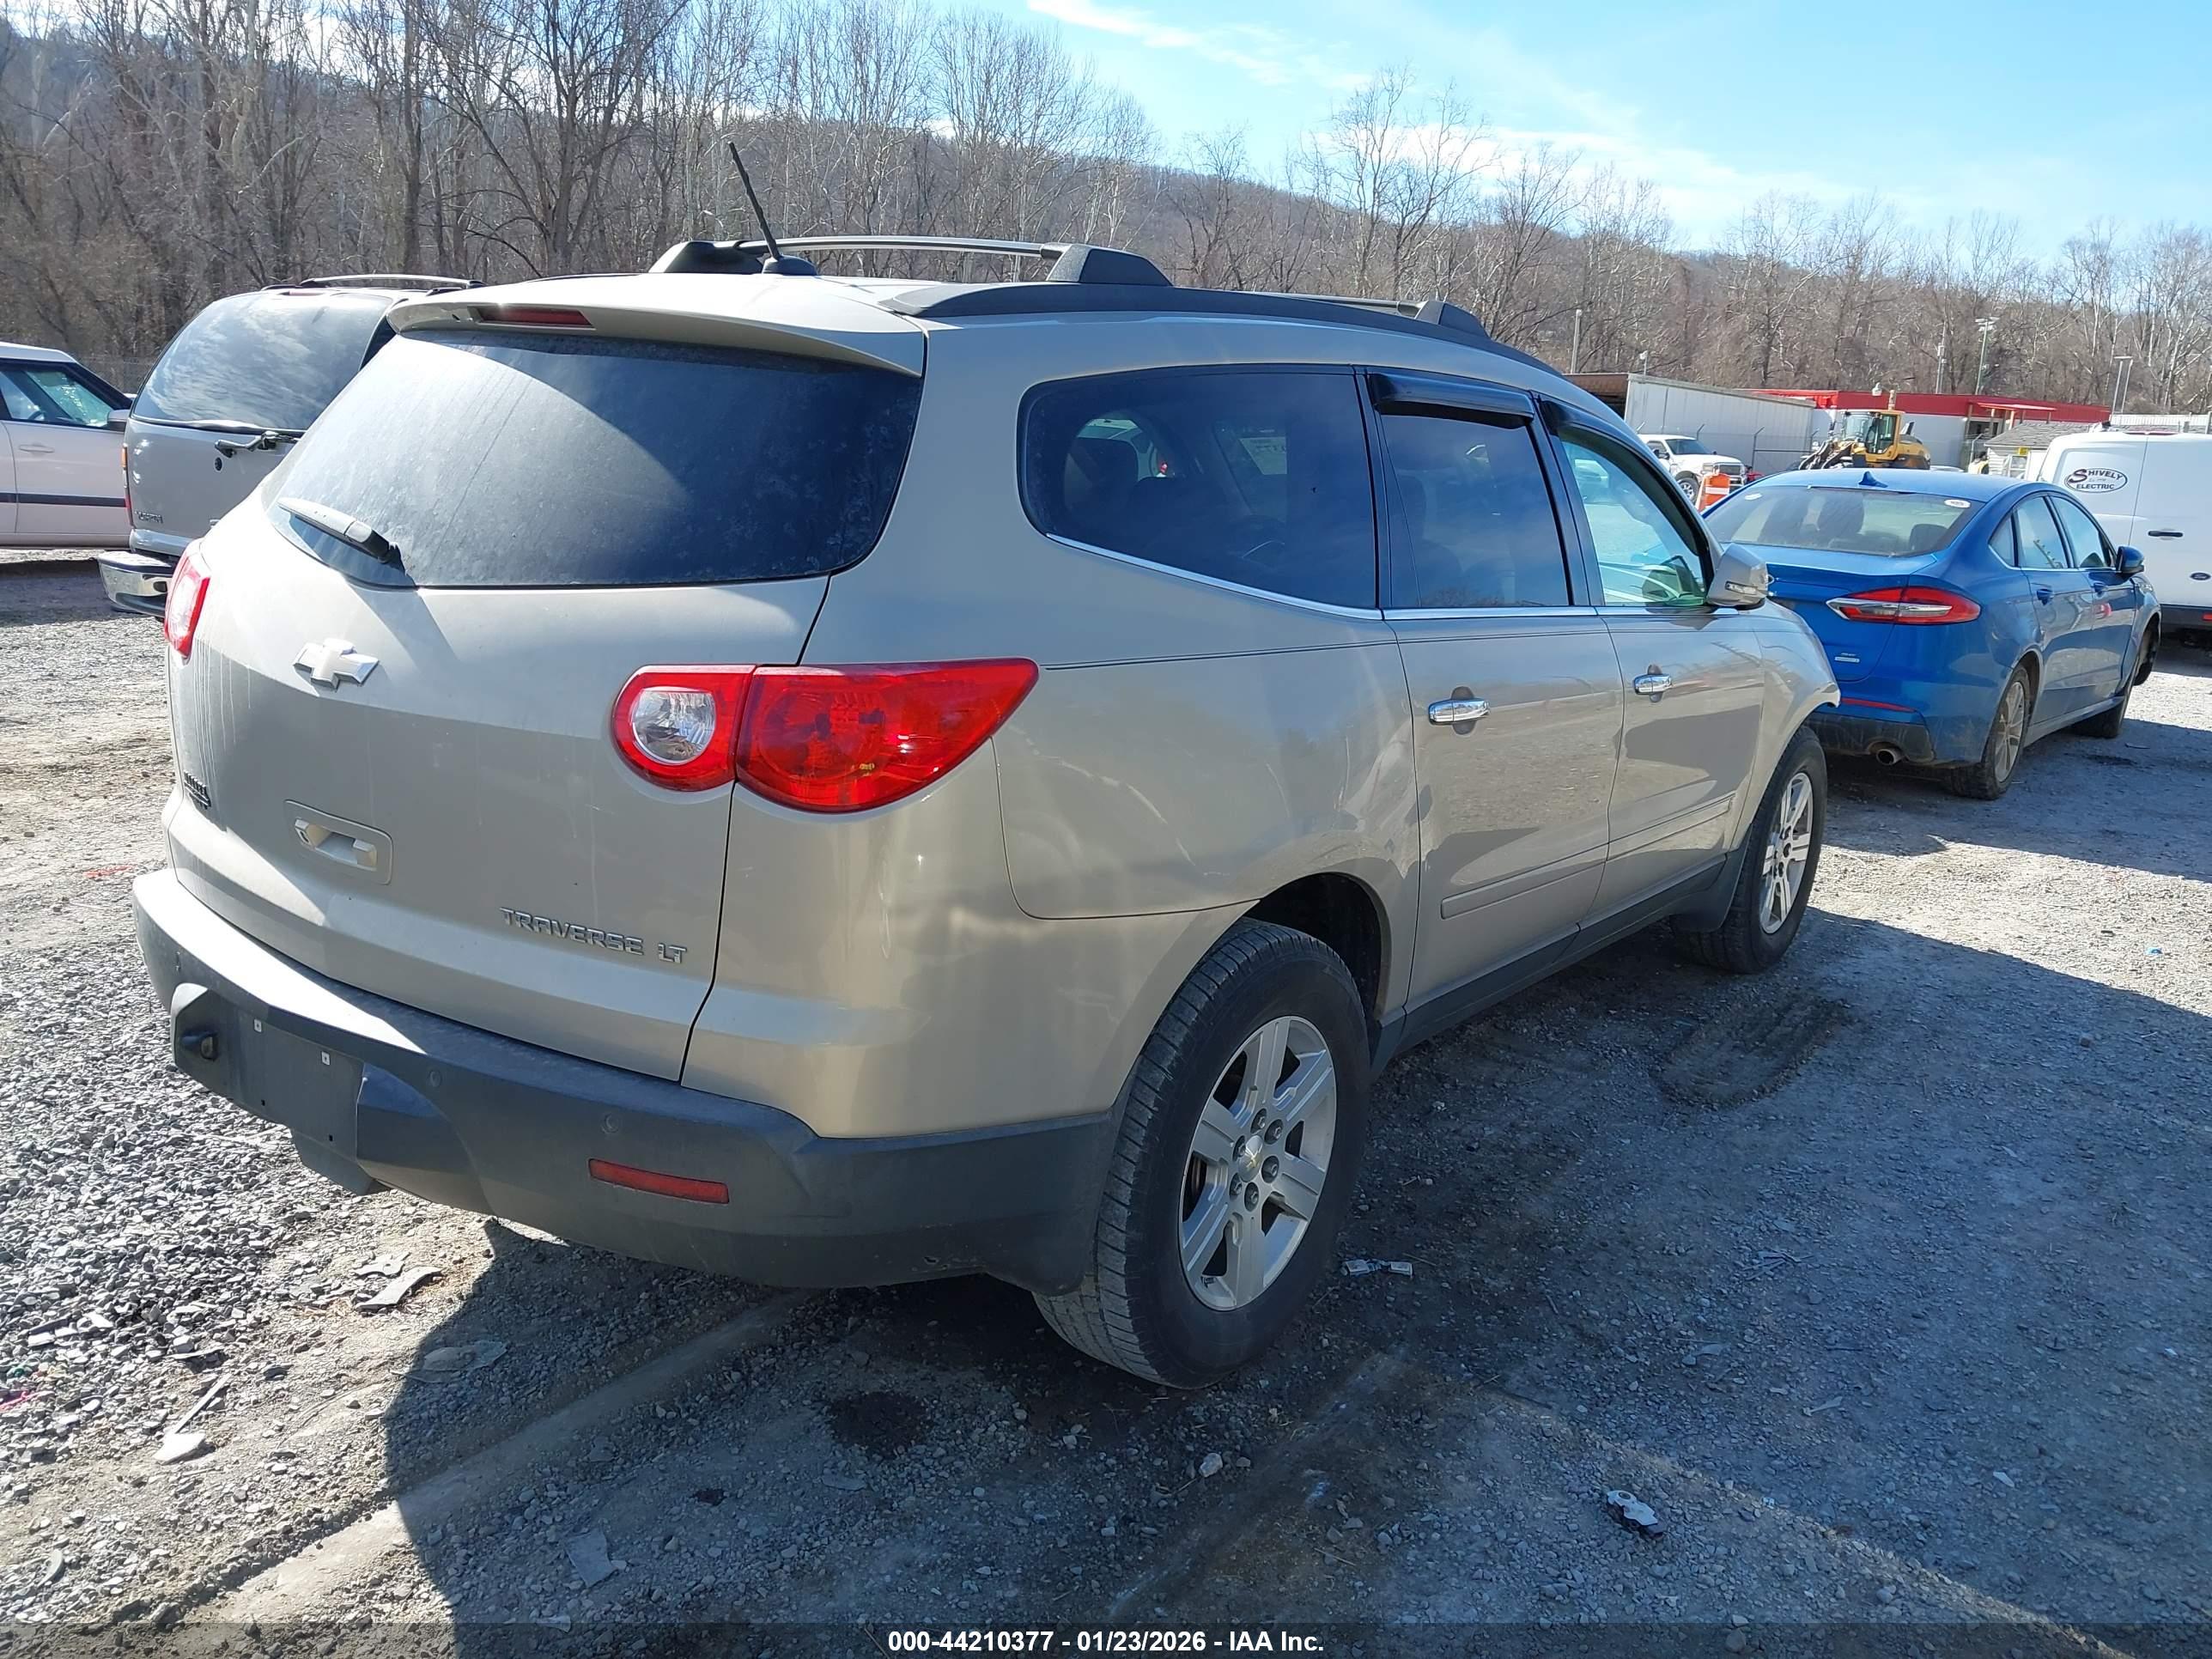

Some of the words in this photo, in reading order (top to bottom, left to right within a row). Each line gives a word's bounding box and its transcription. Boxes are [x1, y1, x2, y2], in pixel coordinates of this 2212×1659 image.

[2068, 469, 2123, 483] SHIVELY
[499, 907, 644, 955] TRAVERSE
[658, 943, 686, 963] LT
